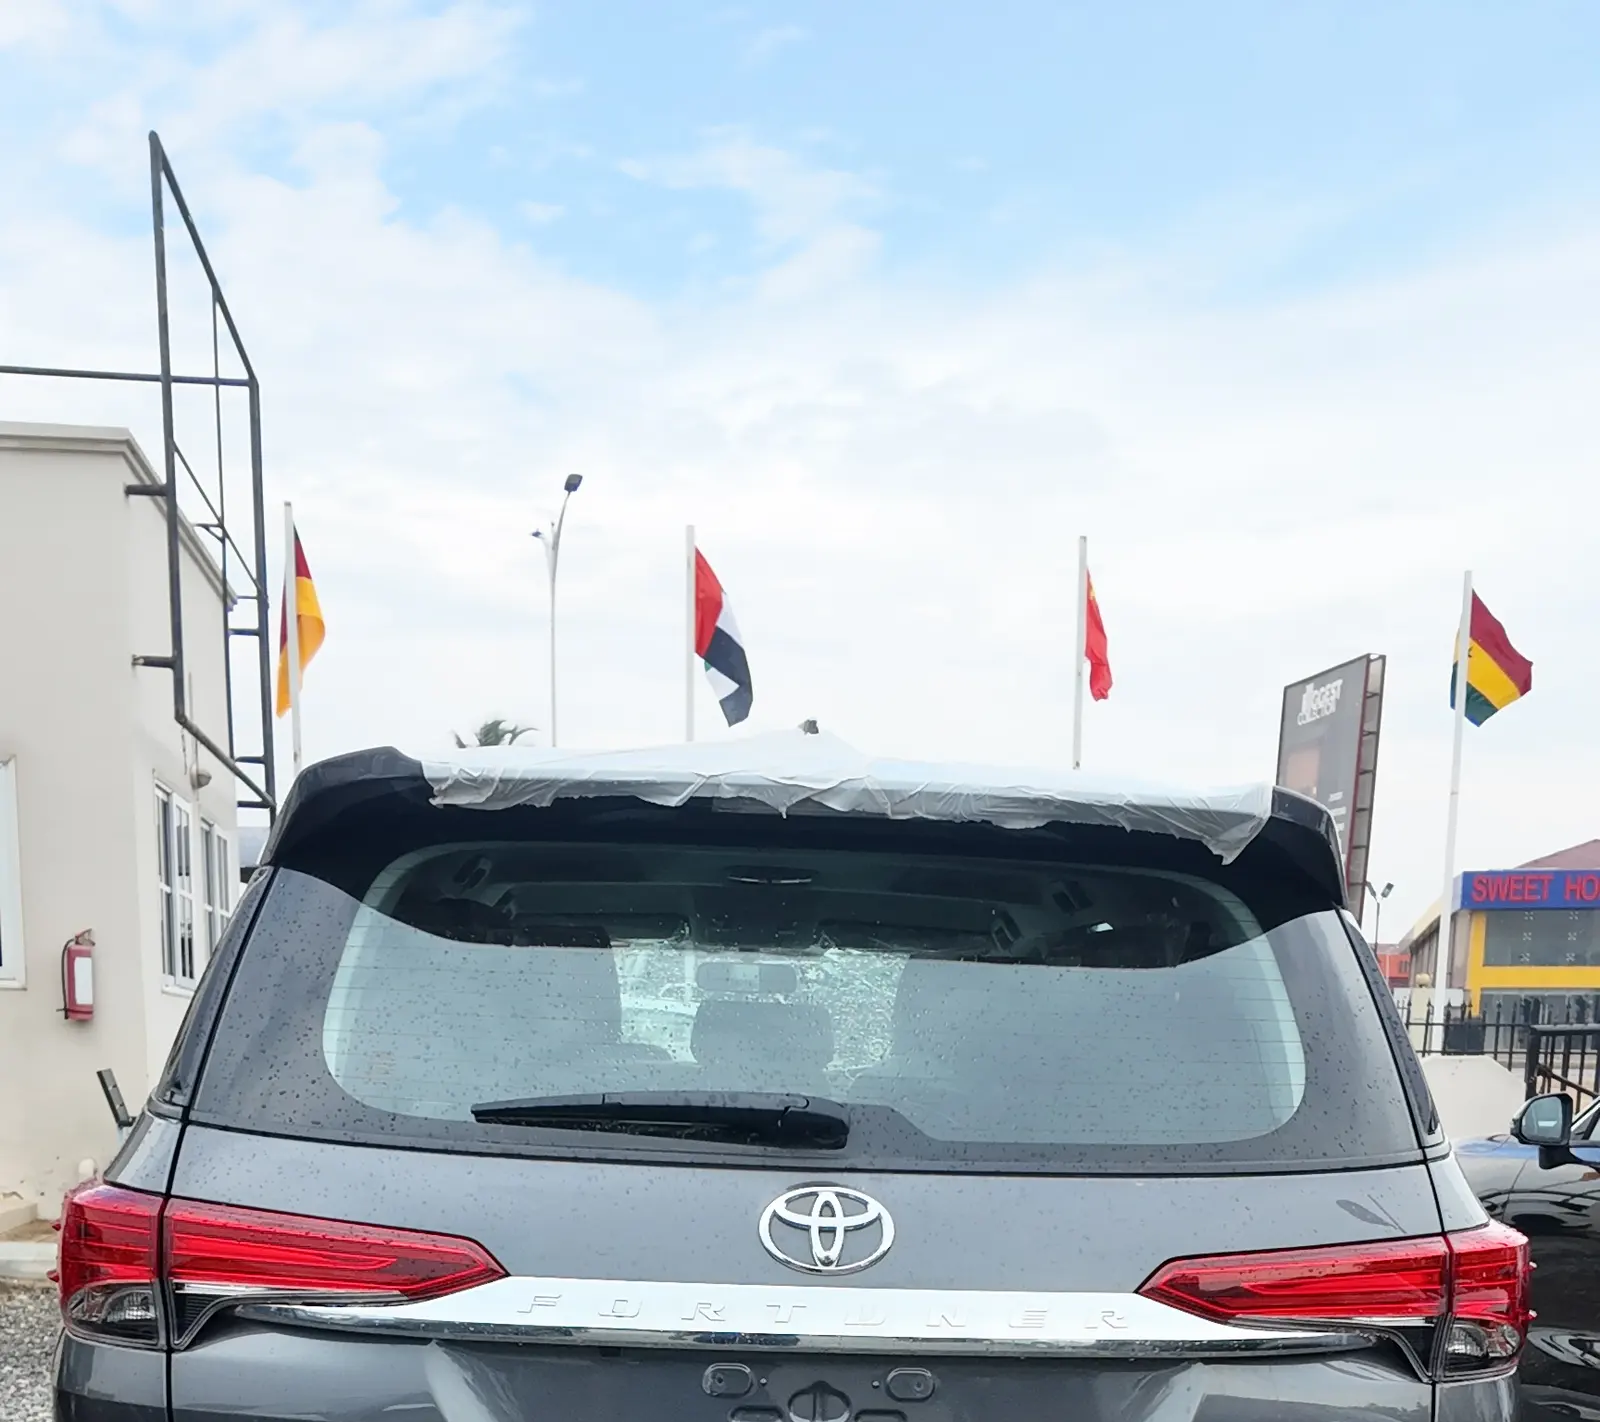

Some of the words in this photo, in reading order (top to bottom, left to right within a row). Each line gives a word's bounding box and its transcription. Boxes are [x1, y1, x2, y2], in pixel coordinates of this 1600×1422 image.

[1471, 873, 1554, 903] SWEET
[1564, 874, 1600, 902] HO
[516, 1294, 1129, 1329] FORTUNER
